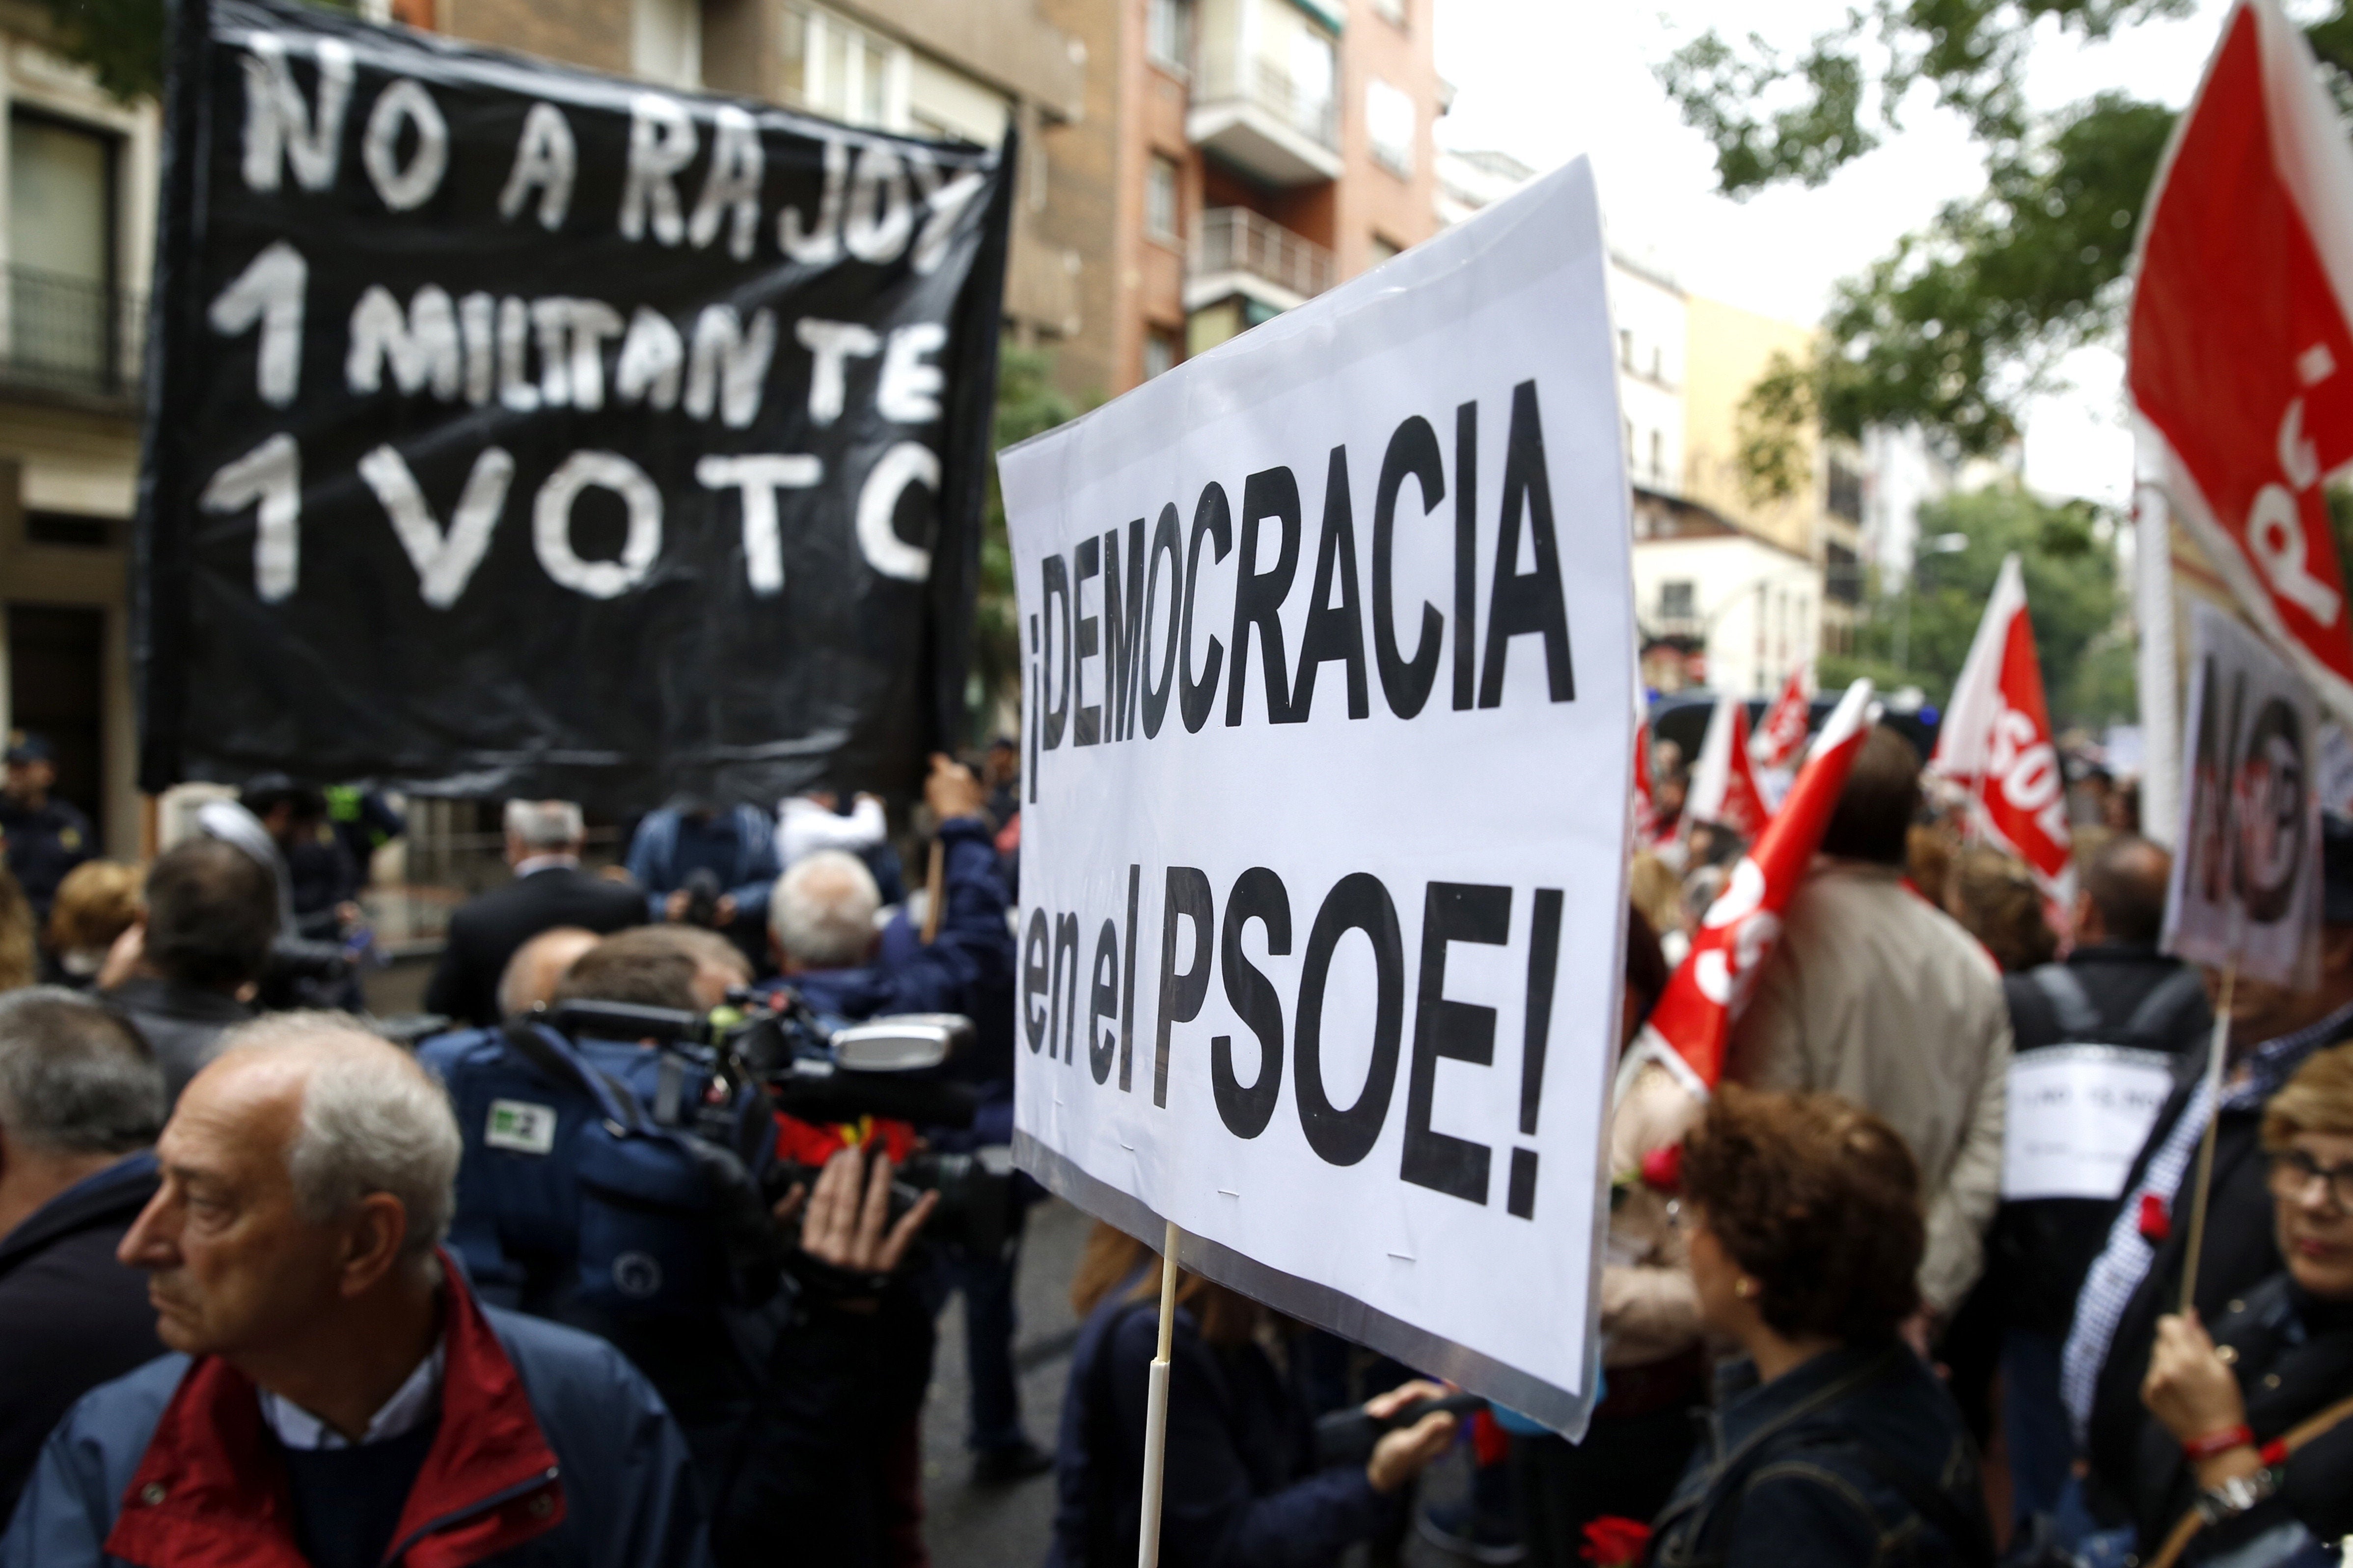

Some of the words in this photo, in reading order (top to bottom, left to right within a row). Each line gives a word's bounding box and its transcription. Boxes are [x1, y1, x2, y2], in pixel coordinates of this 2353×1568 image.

[239, 33, 449, 213] NO
[497, 101, 577, 231] A
[619, 93, 985, 276] RAJOY
[208, 241, 309, 409] 1
[199, 432, 302, 605] 1
[1029, 379, 1575, 804] ¡DEMOCRACIA
[1024, 907, 1079, 1066] en
[1089, 864, 1141, 1093] el
[1153, 866, 1564, 1221] PSOE!
